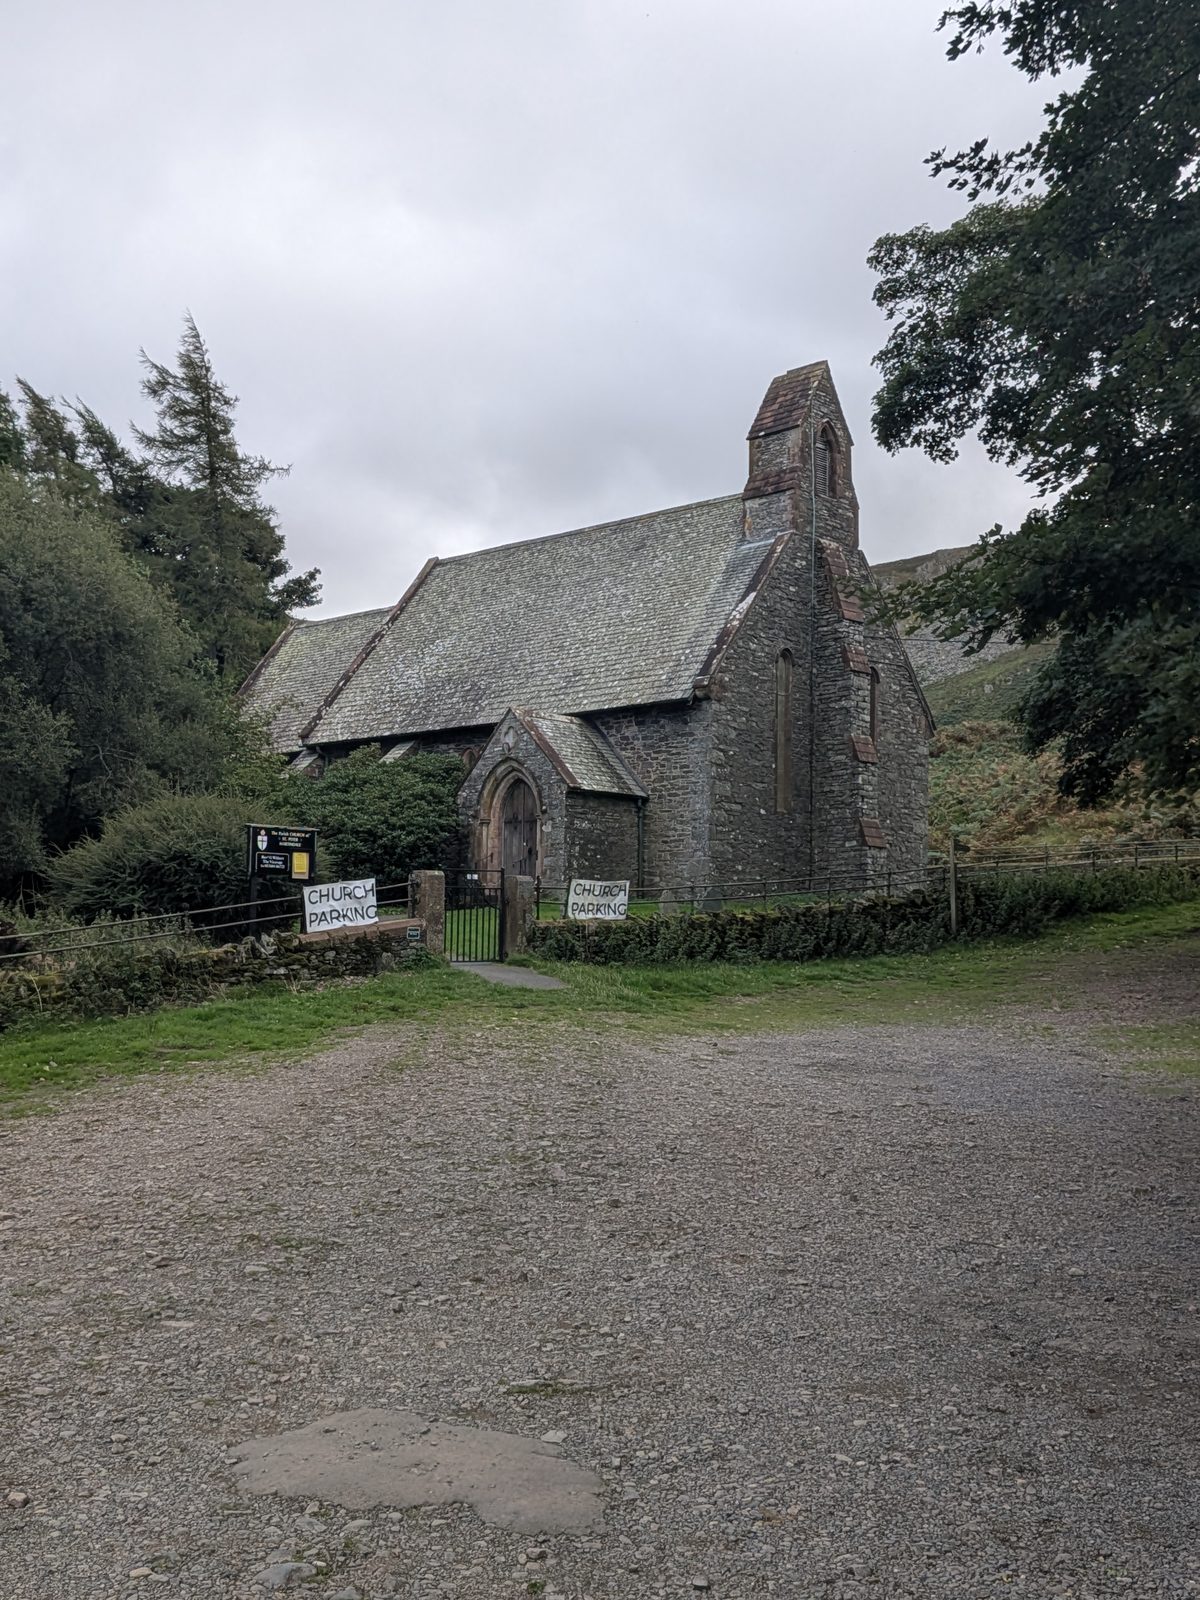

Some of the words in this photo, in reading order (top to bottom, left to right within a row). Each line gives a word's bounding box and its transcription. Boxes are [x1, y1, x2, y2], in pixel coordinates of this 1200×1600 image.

[308, 883, 375, 904] CHURCH
[574, 883, 627, 897] CHURCH
[309, 905, 377, 928] PARKING
[572, 902, 627, 916] PARKING
